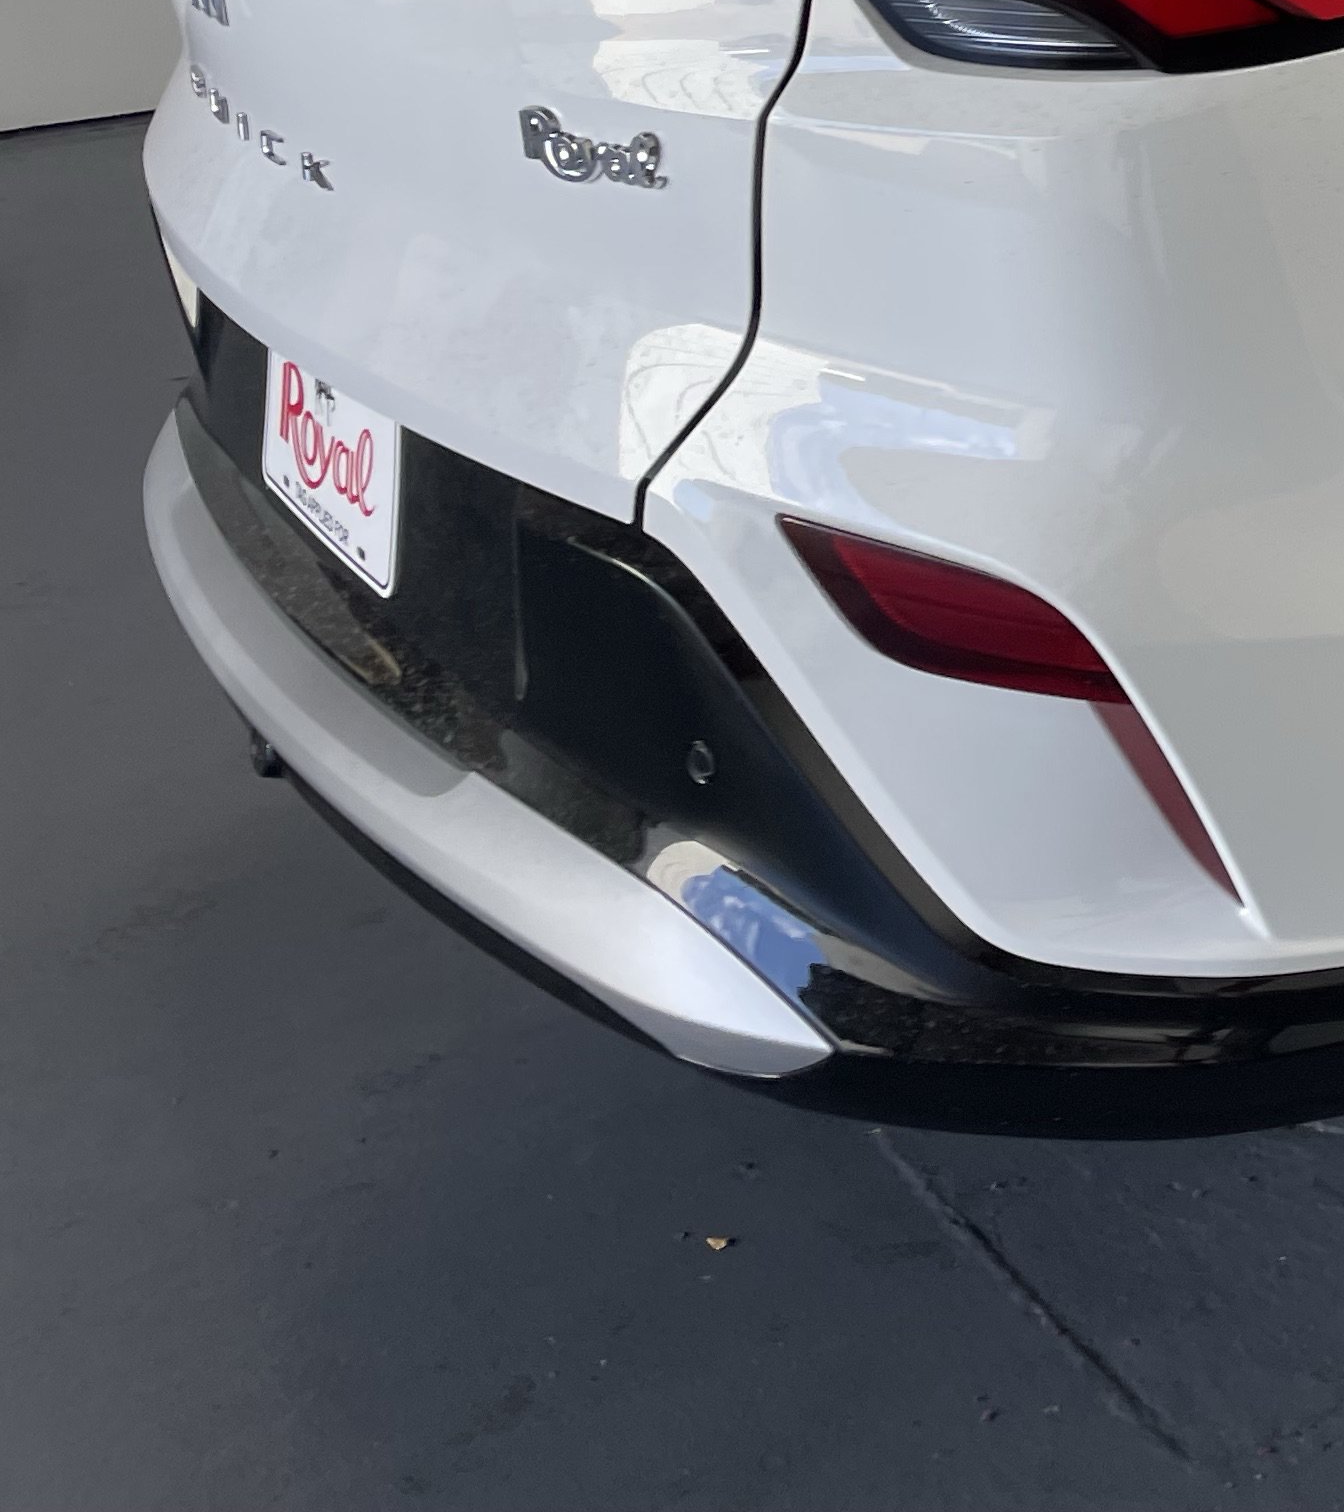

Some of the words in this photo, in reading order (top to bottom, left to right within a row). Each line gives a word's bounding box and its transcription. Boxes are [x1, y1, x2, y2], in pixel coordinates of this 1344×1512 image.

[190, 64, 334, 191] BUICK
[518, 105, 668, 190] Royal
[280, 360, 376, 516] Royal
